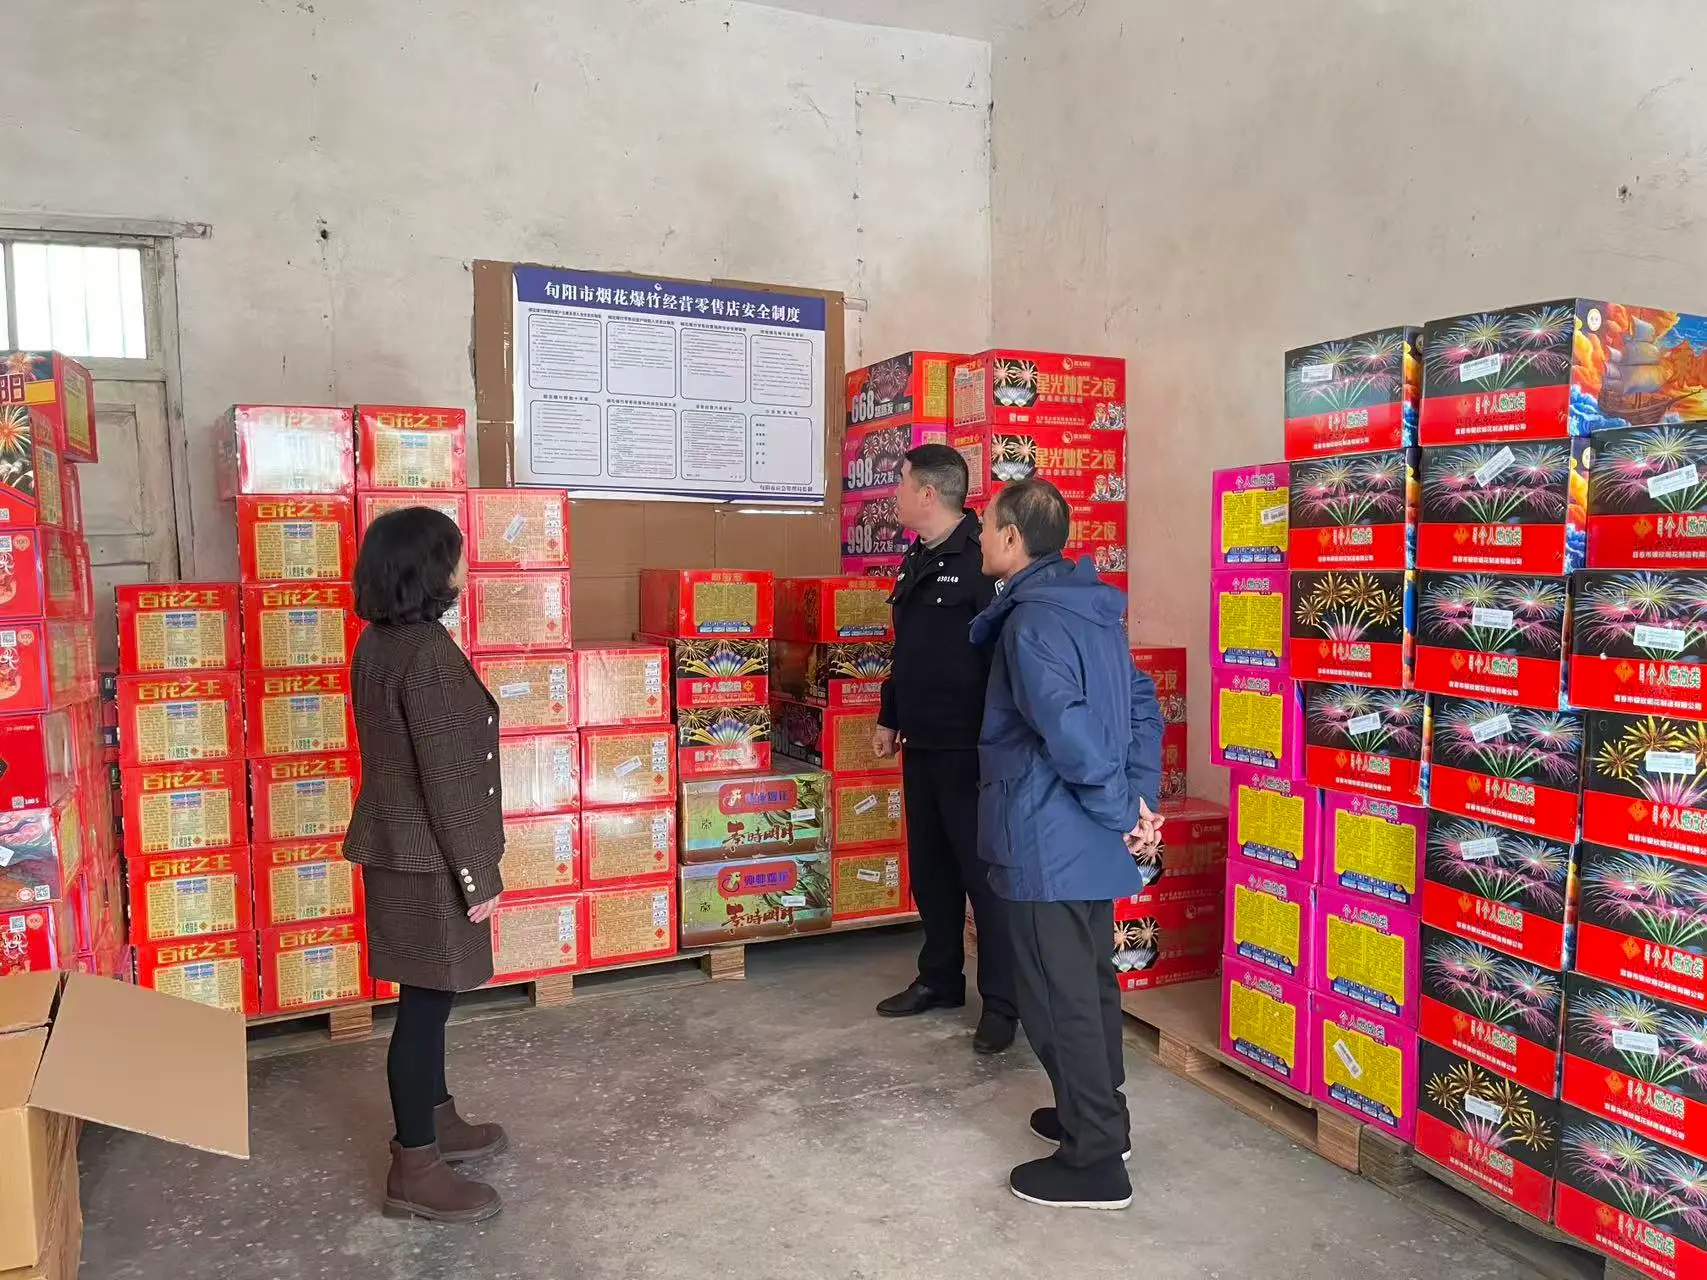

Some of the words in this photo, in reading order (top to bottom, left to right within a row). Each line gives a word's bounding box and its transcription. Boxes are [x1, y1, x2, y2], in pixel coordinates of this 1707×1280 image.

[543, 281, 801, 323] 旬阳市烟花爆竹经营零售店安全制度
[1036, 373, 1116, 398] 星光灿烂之夜
[377, 412, 449, 429] 百花之王
[1035, 448, 1116, 471] 星光灿烂之夜
[848, 457, 873, 489] 998
[257, 501, 336, 518] 百花之王
[847, 525, 873, 554] 998
[138, 590, 221, 609] 百花之王
[263, 588, 341, 606] 百花之王
[264, 674, 342, 693] 百花之王
[1647, 663, 1701, 688] 个人燃放类
[138, 680, 222, 700] 百花之王
[142, 768, 225, 790] 百花之王
[272, 758, 348, 778] 百花之王
[149, 854, 232, 877] 百花之王
[279, 923, 356, 948] 百花之王
[157, 938, 238, 964] 百花之王
[1652, 945, 1704, 979] 个人燃放类
[1634, 1081, 1685, 1121] 个人燃放类
